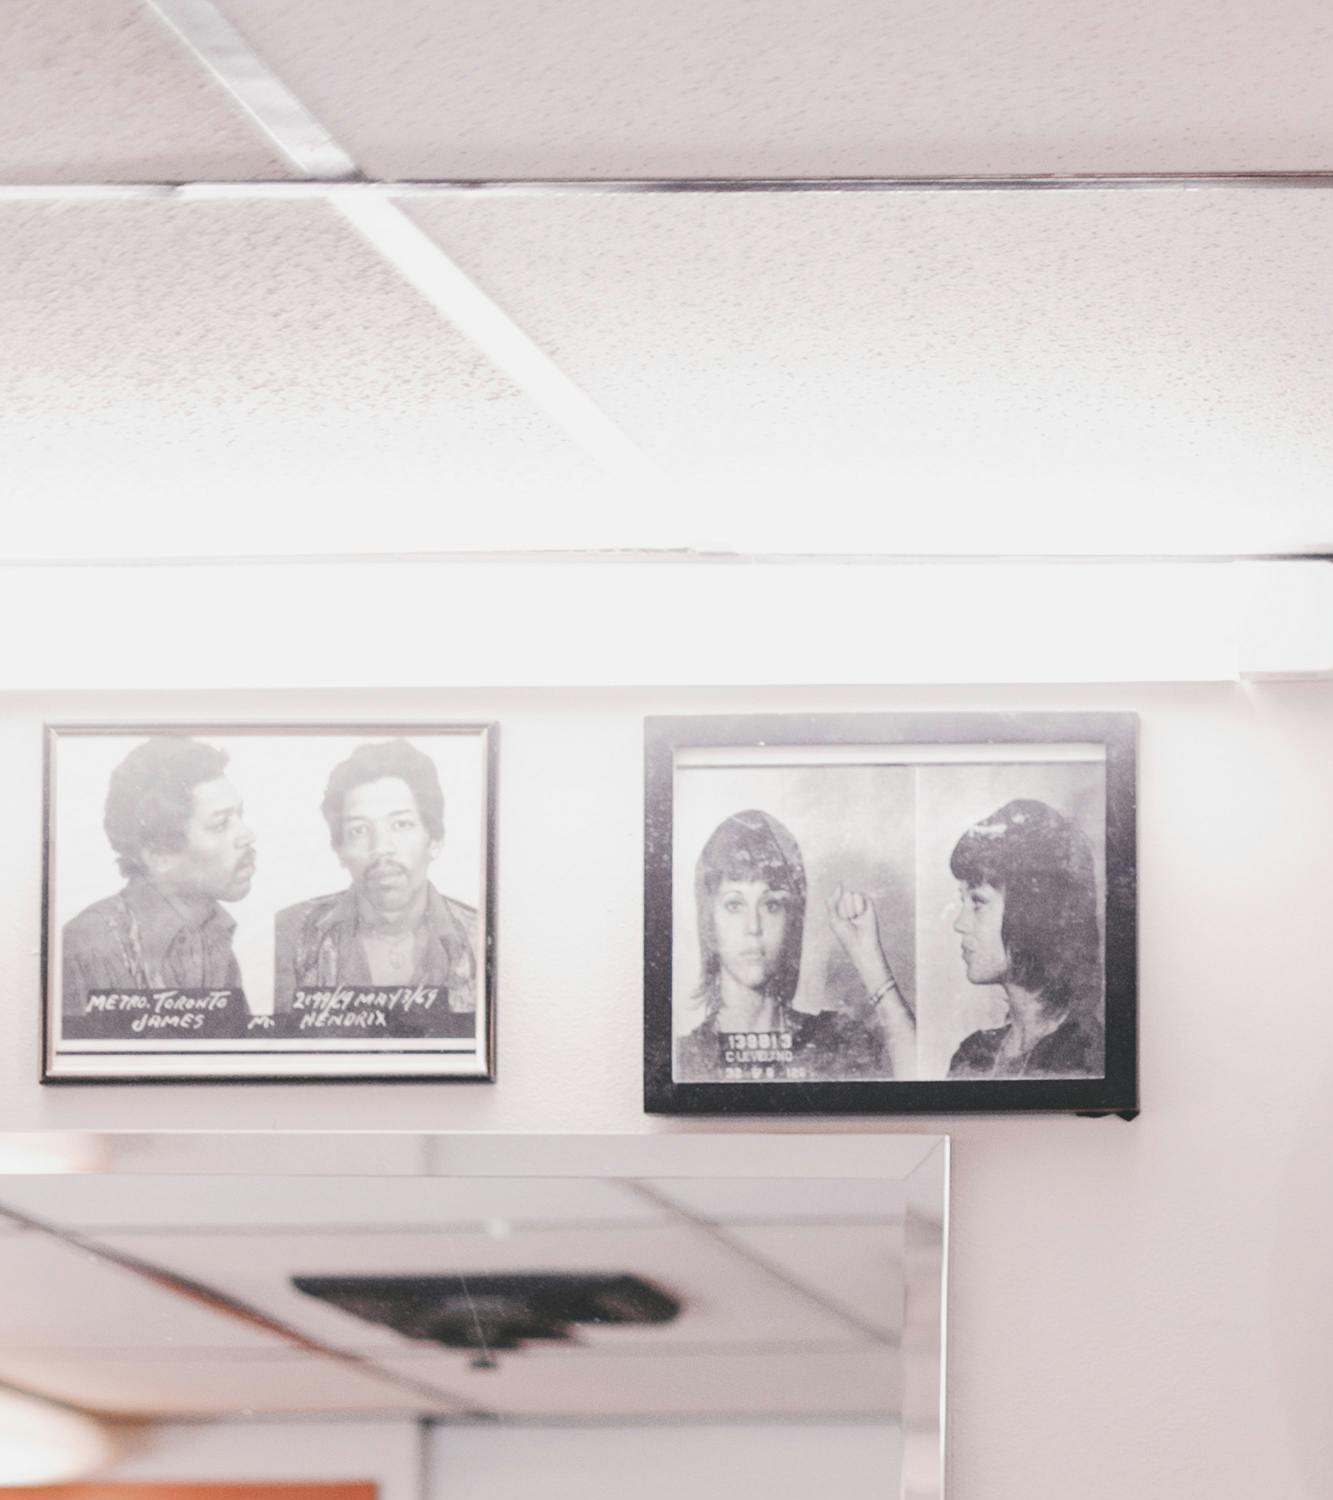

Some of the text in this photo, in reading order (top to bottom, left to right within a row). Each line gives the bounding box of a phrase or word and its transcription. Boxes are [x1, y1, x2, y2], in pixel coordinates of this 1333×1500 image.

[153, 990, 232, 1013] TORONTO
[131, 1013, 205, 1032] JAMES
[299, 1010, 387, 1029] HENDRIX
